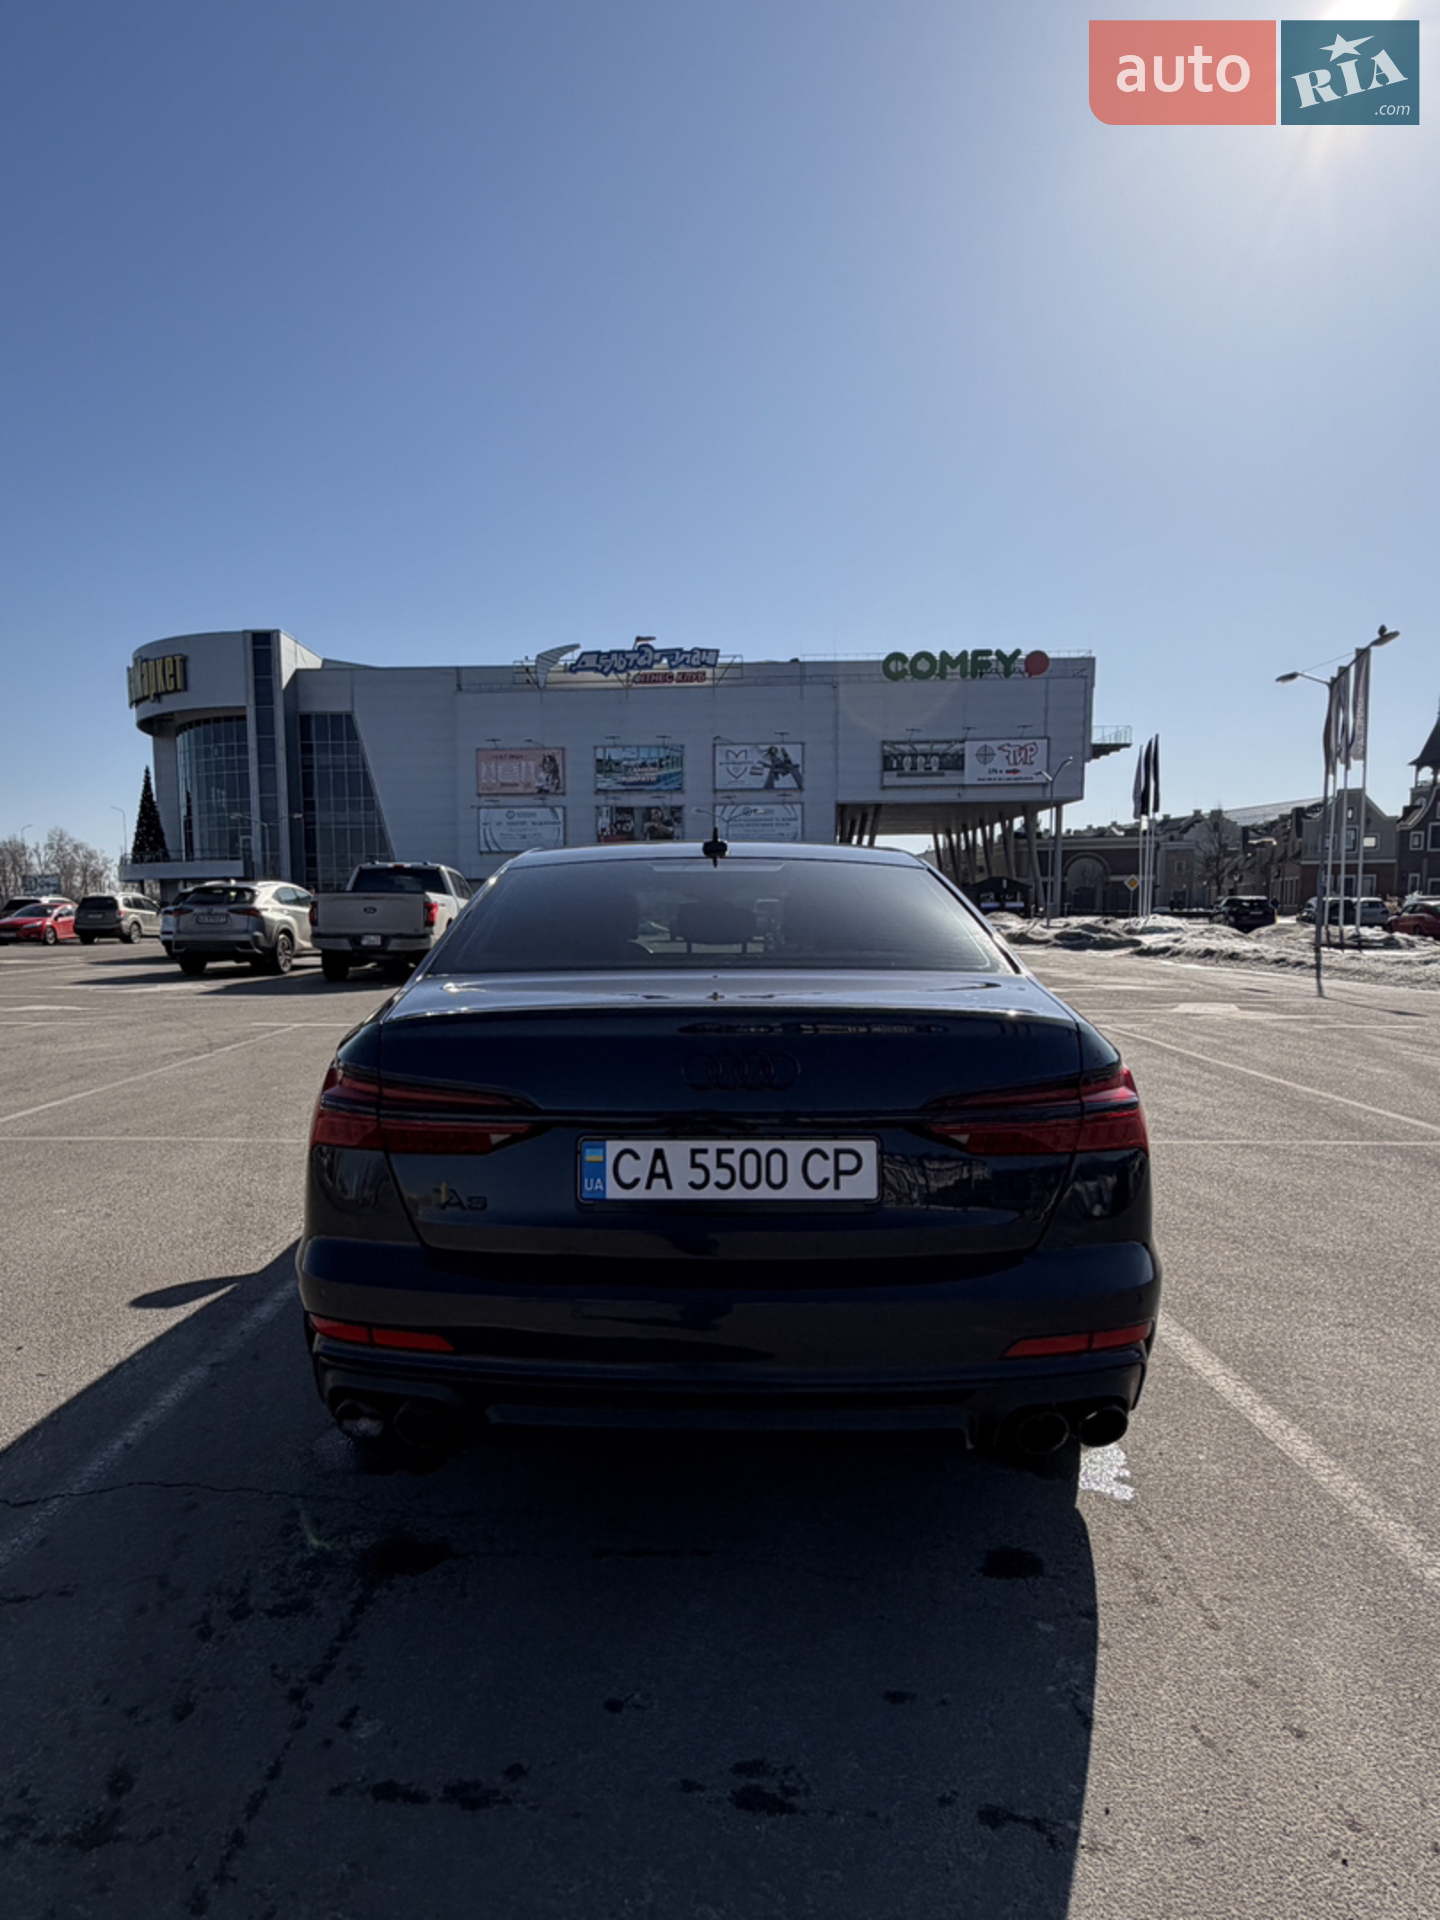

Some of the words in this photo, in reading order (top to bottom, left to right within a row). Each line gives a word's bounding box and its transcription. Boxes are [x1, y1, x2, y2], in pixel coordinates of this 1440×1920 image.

[882, 648, 1021, 681] COMFY
[584, 1178, 604, 1191] UA
[612, 1148, 673, 1190] CA
[687, 1148, 788, 1190] 5500
[801, 1148, 863, 1190] CP
